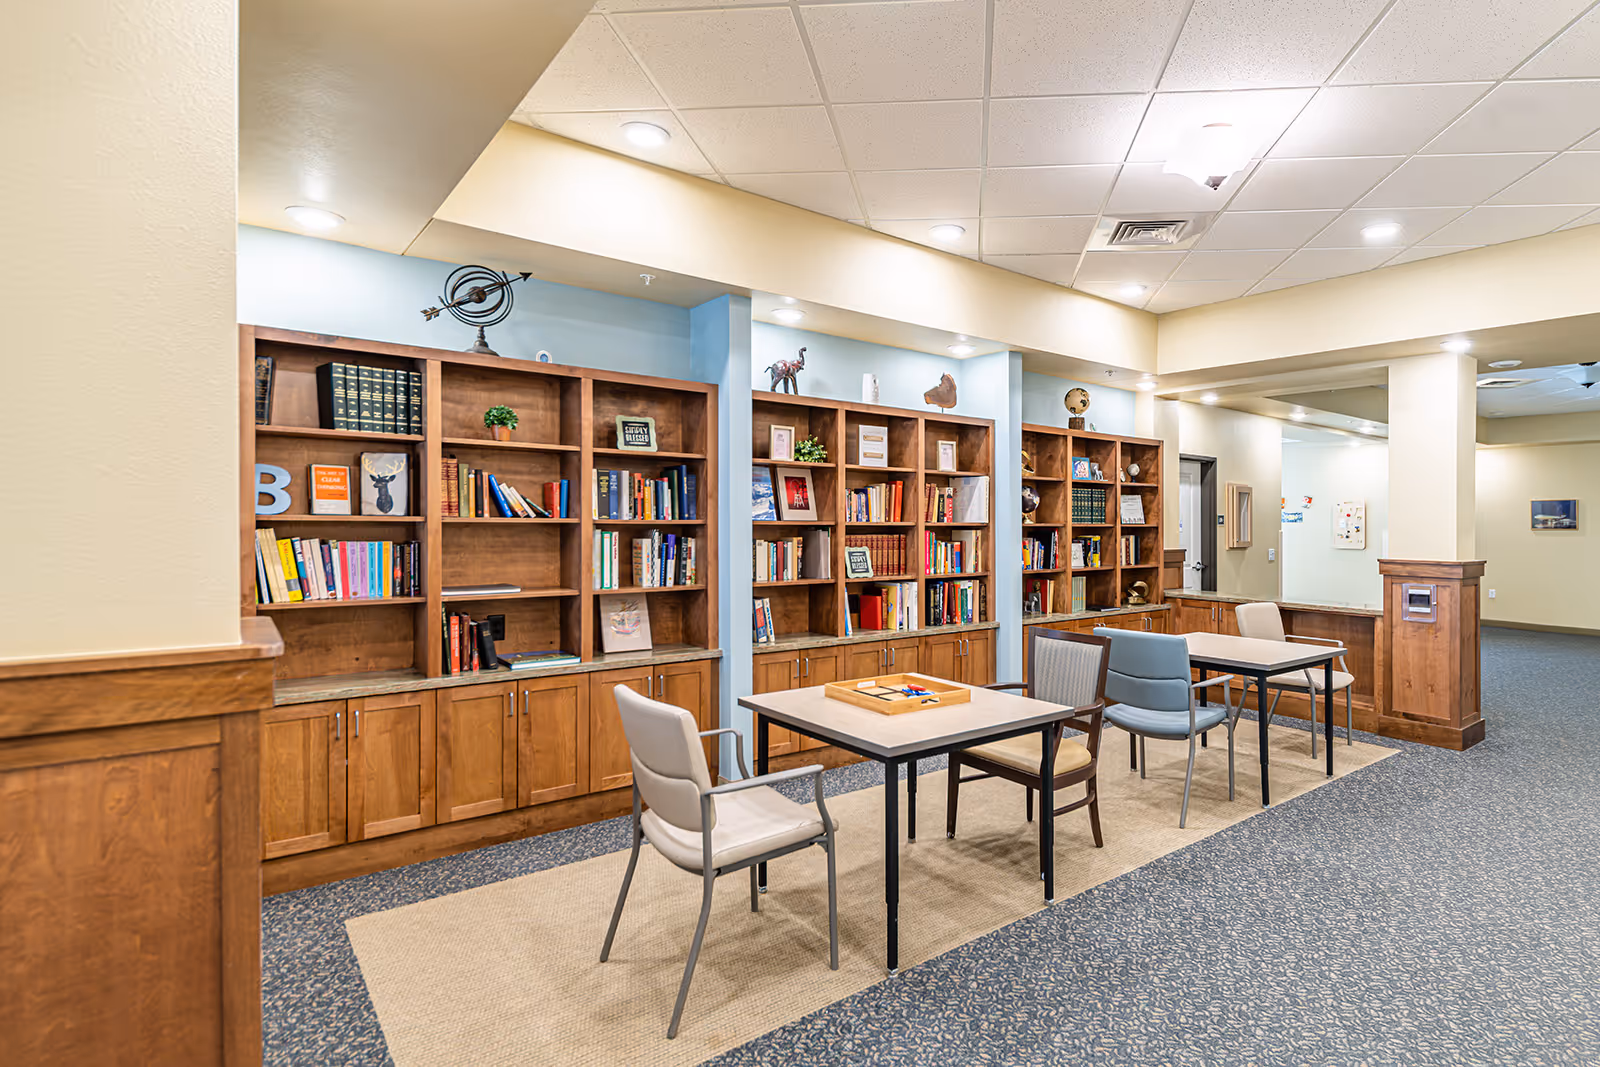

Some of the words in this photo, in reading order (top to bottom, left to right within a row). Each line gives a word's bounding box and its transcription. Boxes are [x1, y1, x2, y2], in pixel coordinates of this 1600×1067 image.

[625, 426, 648, 434] SIMPLY
[626, 434, 649, 442] BLESSED
[255, 463, 292, 515] B
